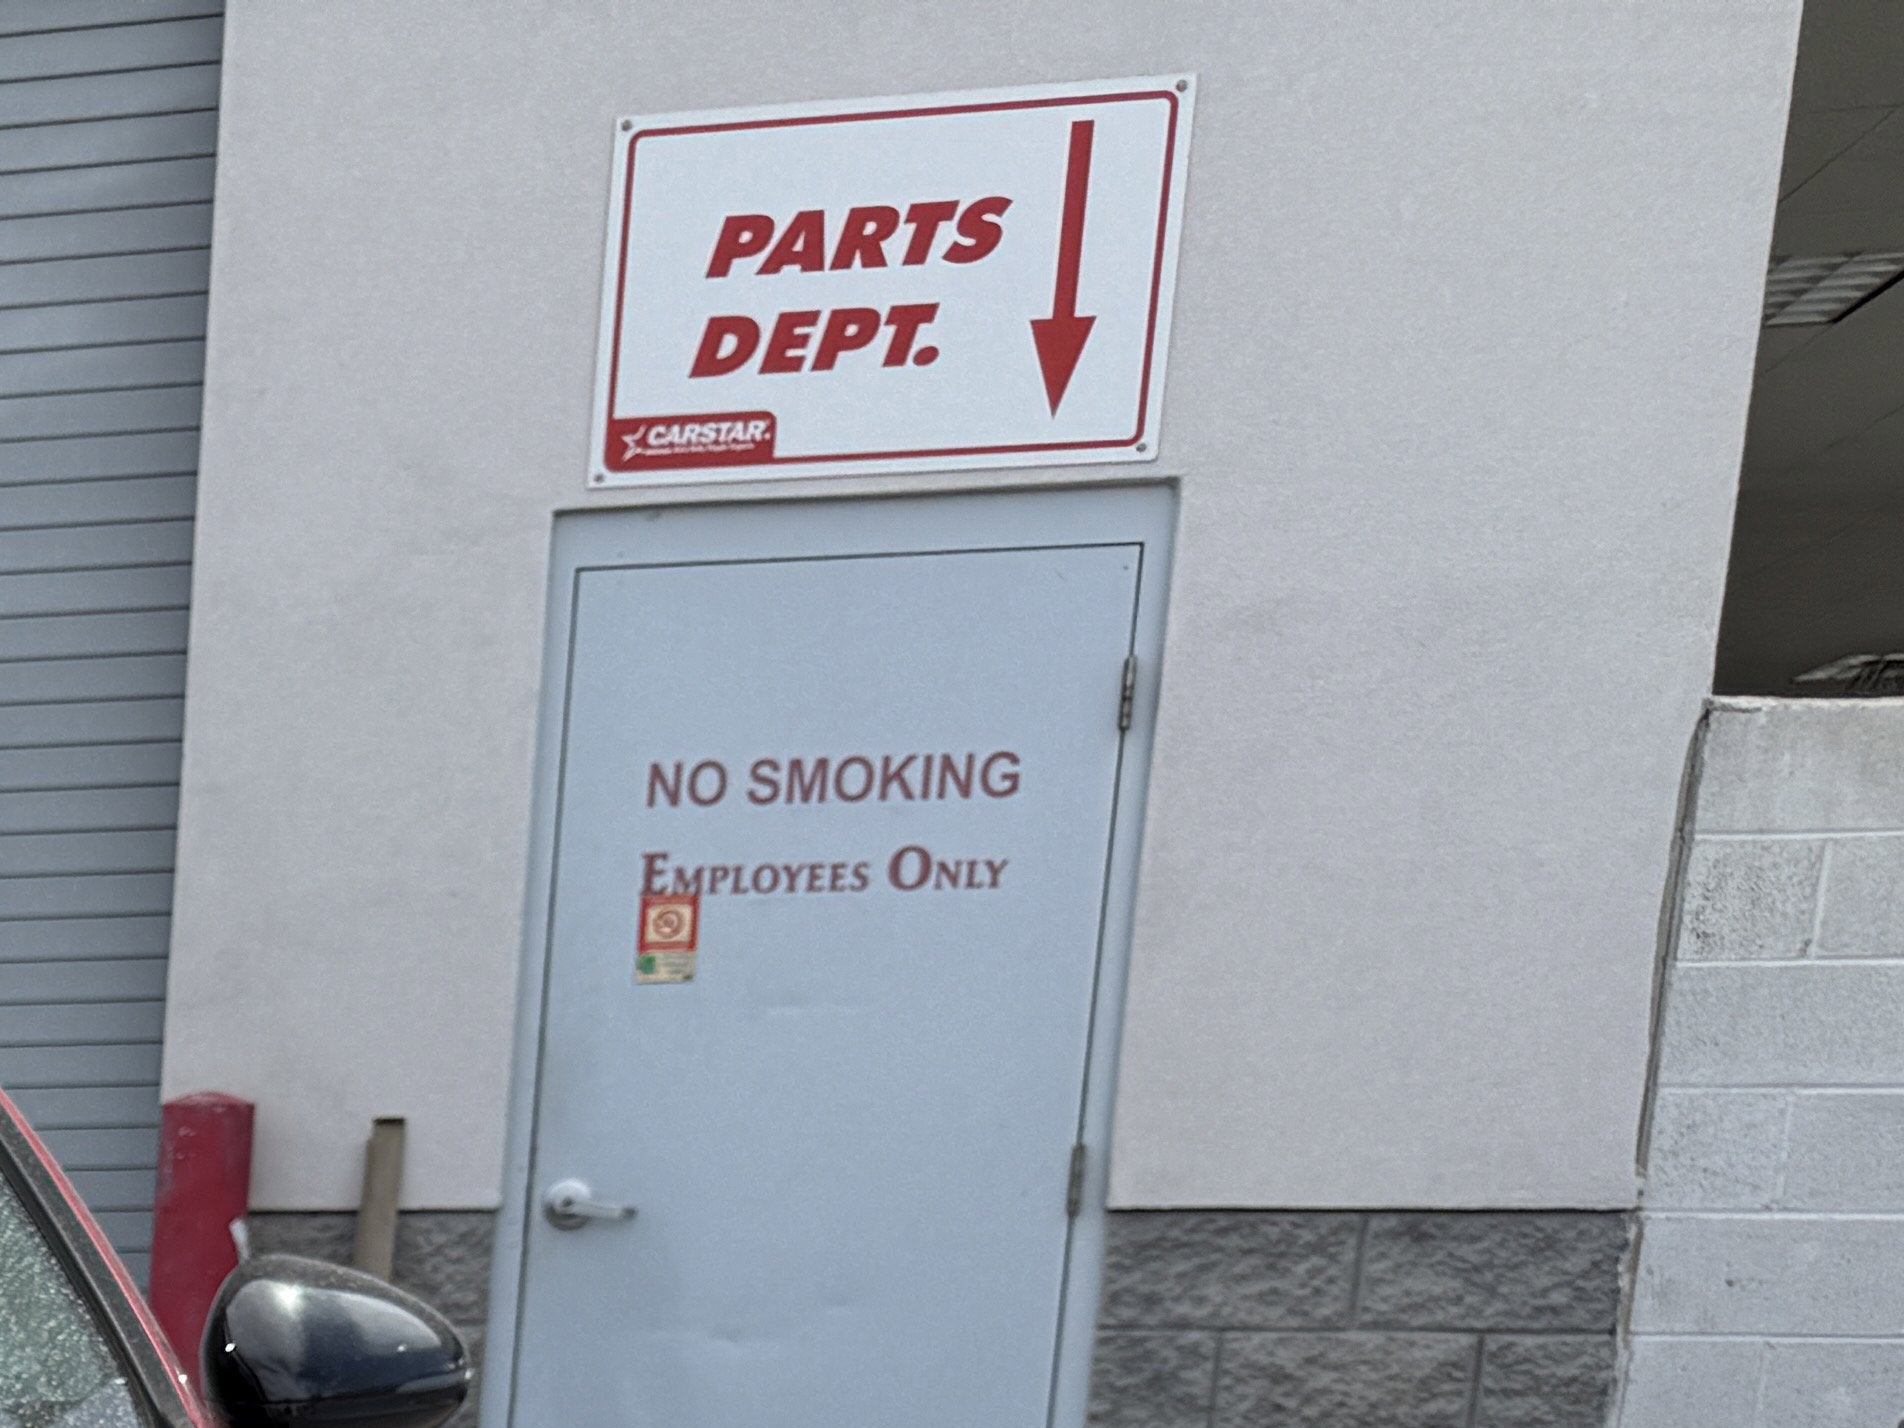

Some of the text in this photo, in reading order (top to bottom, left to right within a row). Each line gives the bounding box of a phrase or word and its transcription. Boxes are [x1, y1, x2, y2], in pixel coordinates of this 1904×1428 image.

[706, 195, 1013, 278] PARTS
[688, 302, 940, 378] DEPT.
[646, 751, 1022, 808] NO SMOKING
